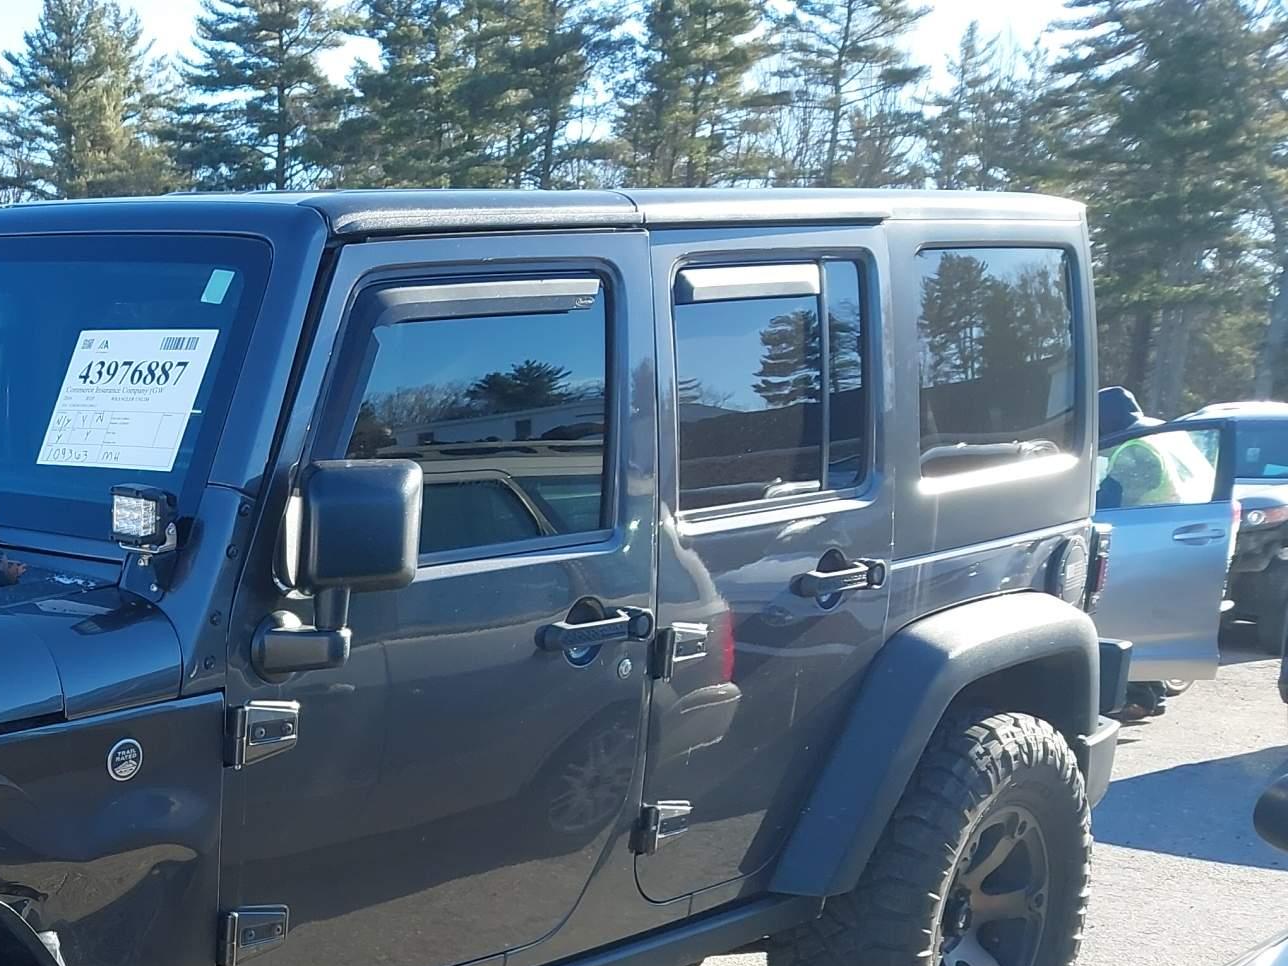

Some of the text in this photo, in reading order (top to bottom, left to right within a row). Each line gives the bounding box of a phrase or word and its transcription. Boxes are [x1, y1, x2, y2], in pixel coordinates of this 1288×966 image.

[78, 360, 190, 386] 43976887
[122, 386, 149, 397] Company
[115, 753, 137, 762] RATED
[117, 748, 137, 757] TRAIL
